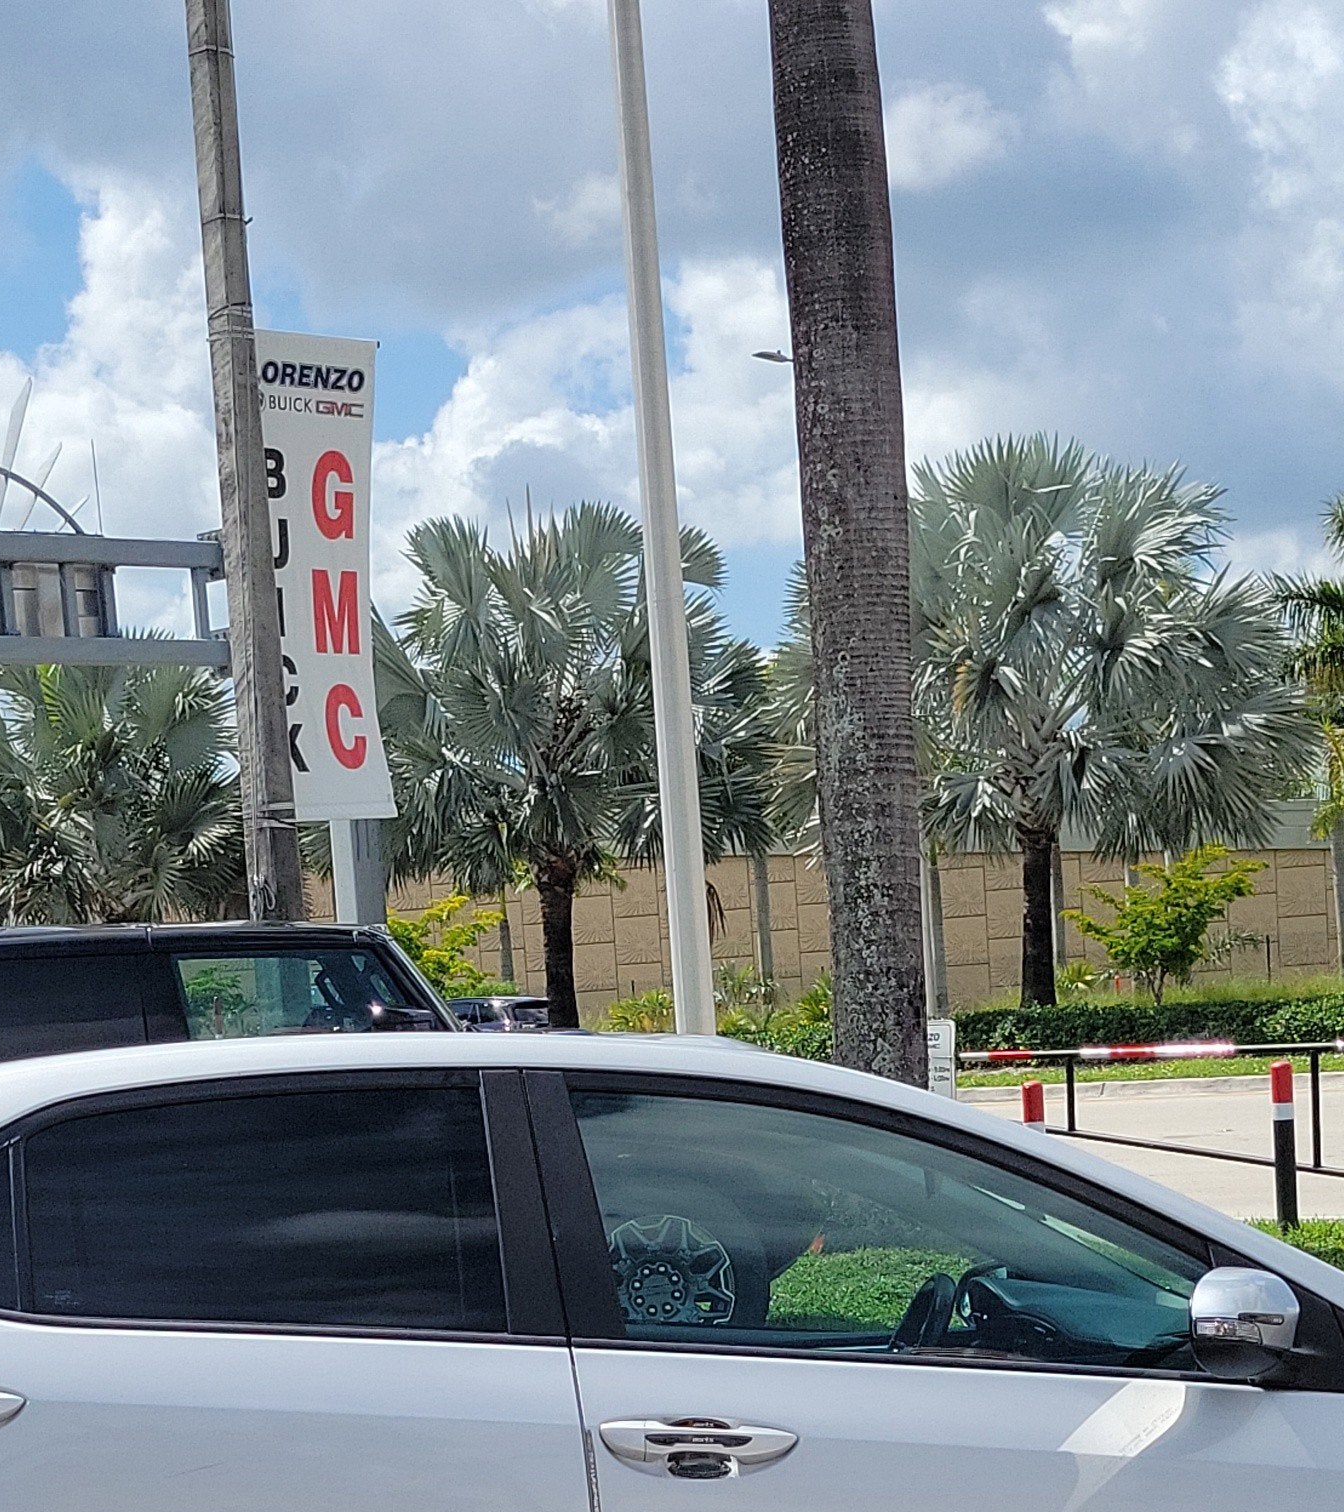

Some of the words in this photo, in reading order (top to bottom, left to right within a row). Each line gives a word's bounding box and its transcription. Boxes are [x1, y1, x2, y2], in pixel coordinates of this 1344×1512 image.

[258, 360, 365, 393] ORENZO
[268, 394, 313, 414] BUICK
[315, 400, 365, 418] GMC
[311, 449, 368, 770] GMC
